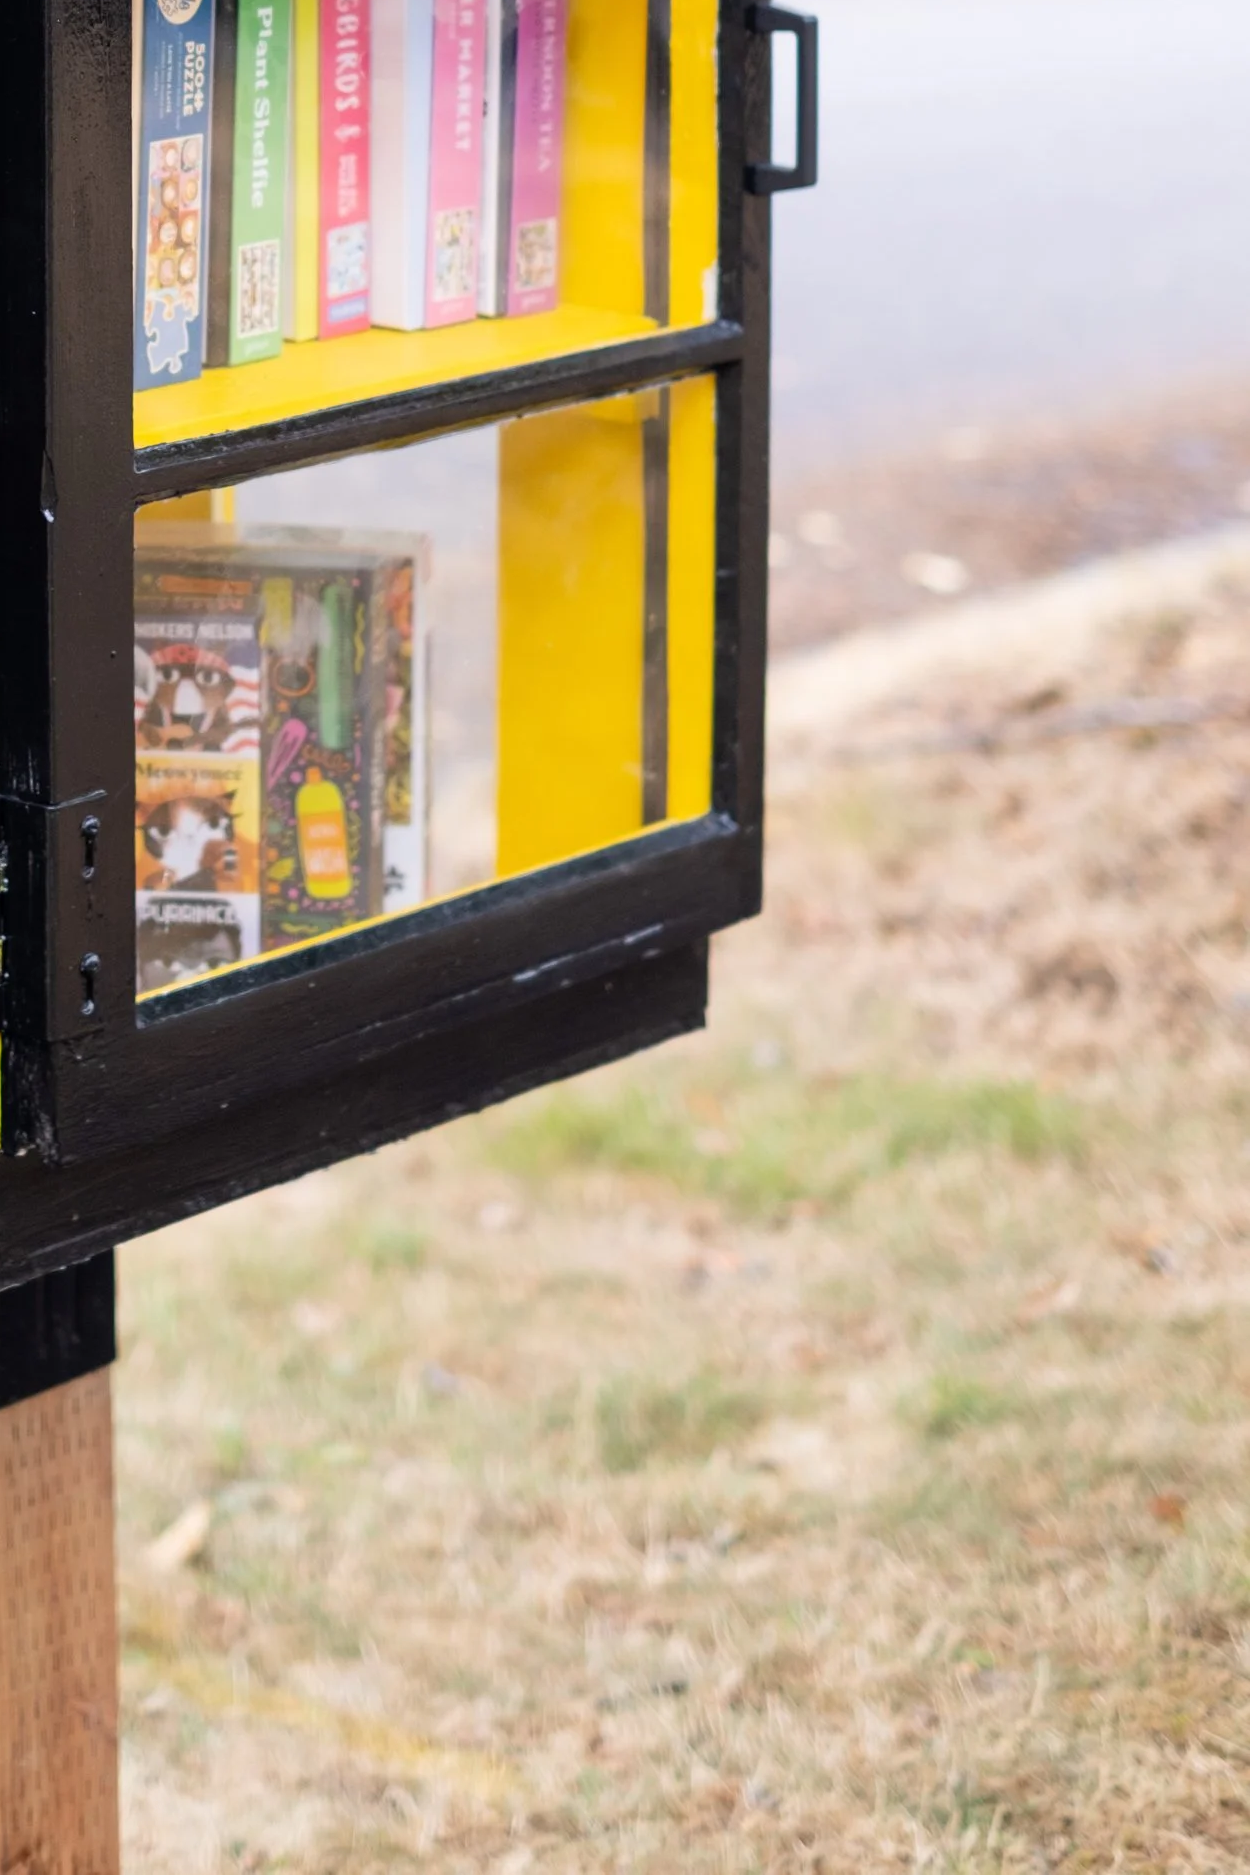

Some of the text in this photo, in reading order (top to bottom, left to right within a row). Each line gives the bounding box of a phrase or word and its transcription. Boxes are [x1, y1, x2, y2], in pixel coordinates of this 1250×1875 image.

[183, 40, 195, 117] PUZZLE
[251, 5, 274, 209] Plant Shelfie
[454, 38, 475, 153] MARKET
